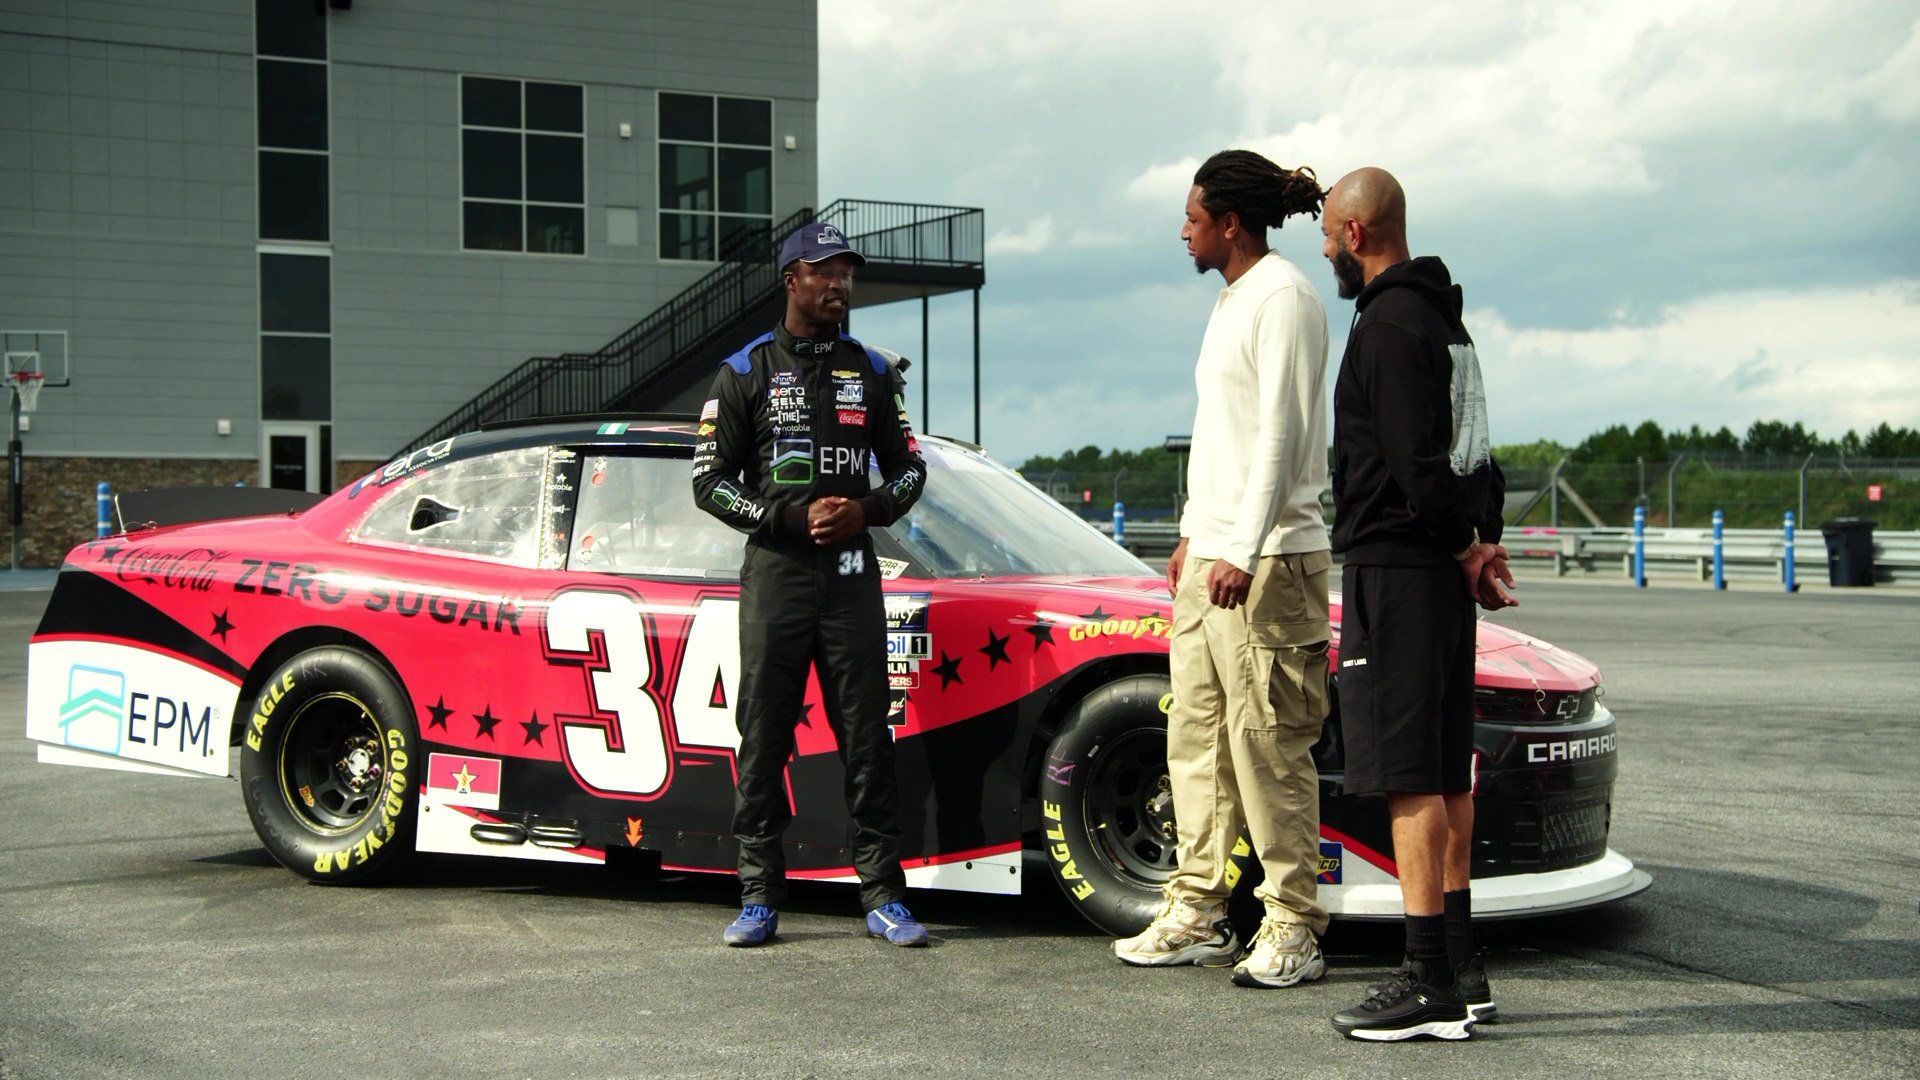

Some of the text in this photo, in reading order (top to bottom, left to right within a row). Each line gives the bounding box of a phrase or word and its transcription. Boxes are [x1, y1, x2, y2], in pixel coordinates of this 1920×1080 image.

[815, 342, 832, 354] EPM
[771, 396, 805, 407] SELE
[835, 403, 868, 412] GOODYEAR
[780, 423, 811, 432] notable
[820, 446, 864, 476] EPM
[731, 496, 765, 521] EPM
[838, 549, 865, 576] 34
[233, 559, 349, 606] ZERO
[364, 574, 523, 636] SUGAR
[914, 637, 923, 654] 1
[543, 588, 743, 798] 34
[128, 691, 212, 758] EPM
[246, 668, 296, 753] EAGLE
[313, 728, 409, 873] GOODYEAR
[1043, 800, 1096, 901] EAGLE
